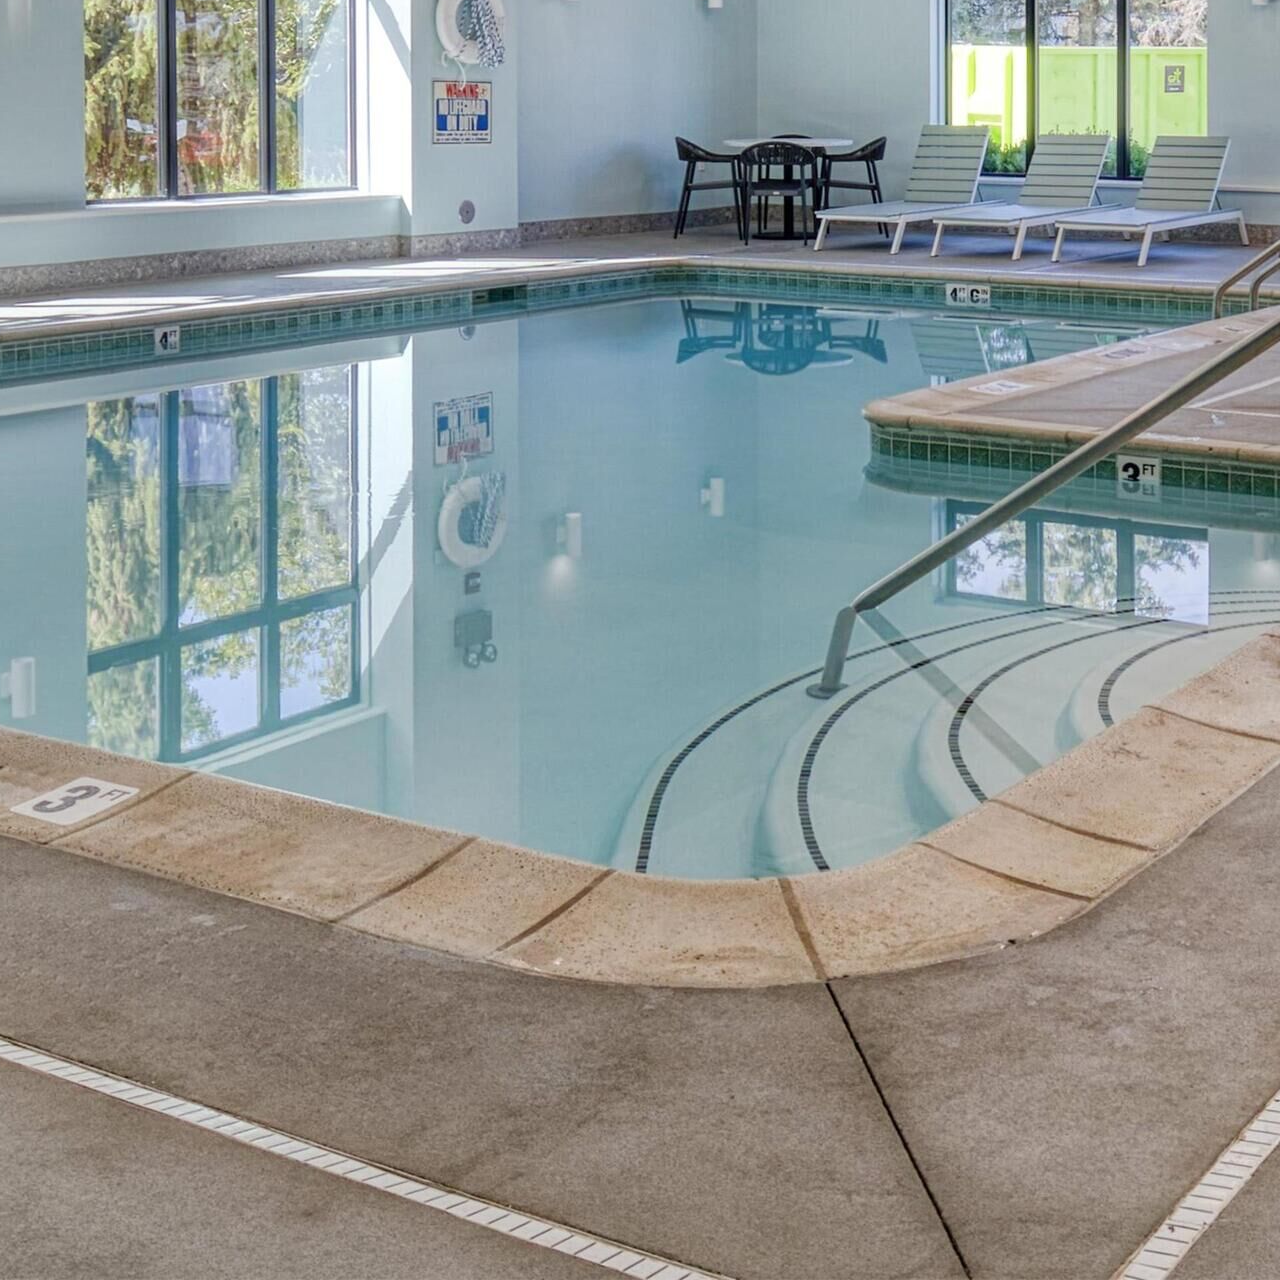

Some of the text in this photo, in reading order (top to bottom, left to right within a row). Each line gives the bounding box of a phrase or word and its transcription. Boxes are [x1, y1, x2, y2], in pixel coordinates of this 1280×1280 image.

[1122, 462, 1156, 482] 3 FT
[32, 785, 131, 813] 3 FT
